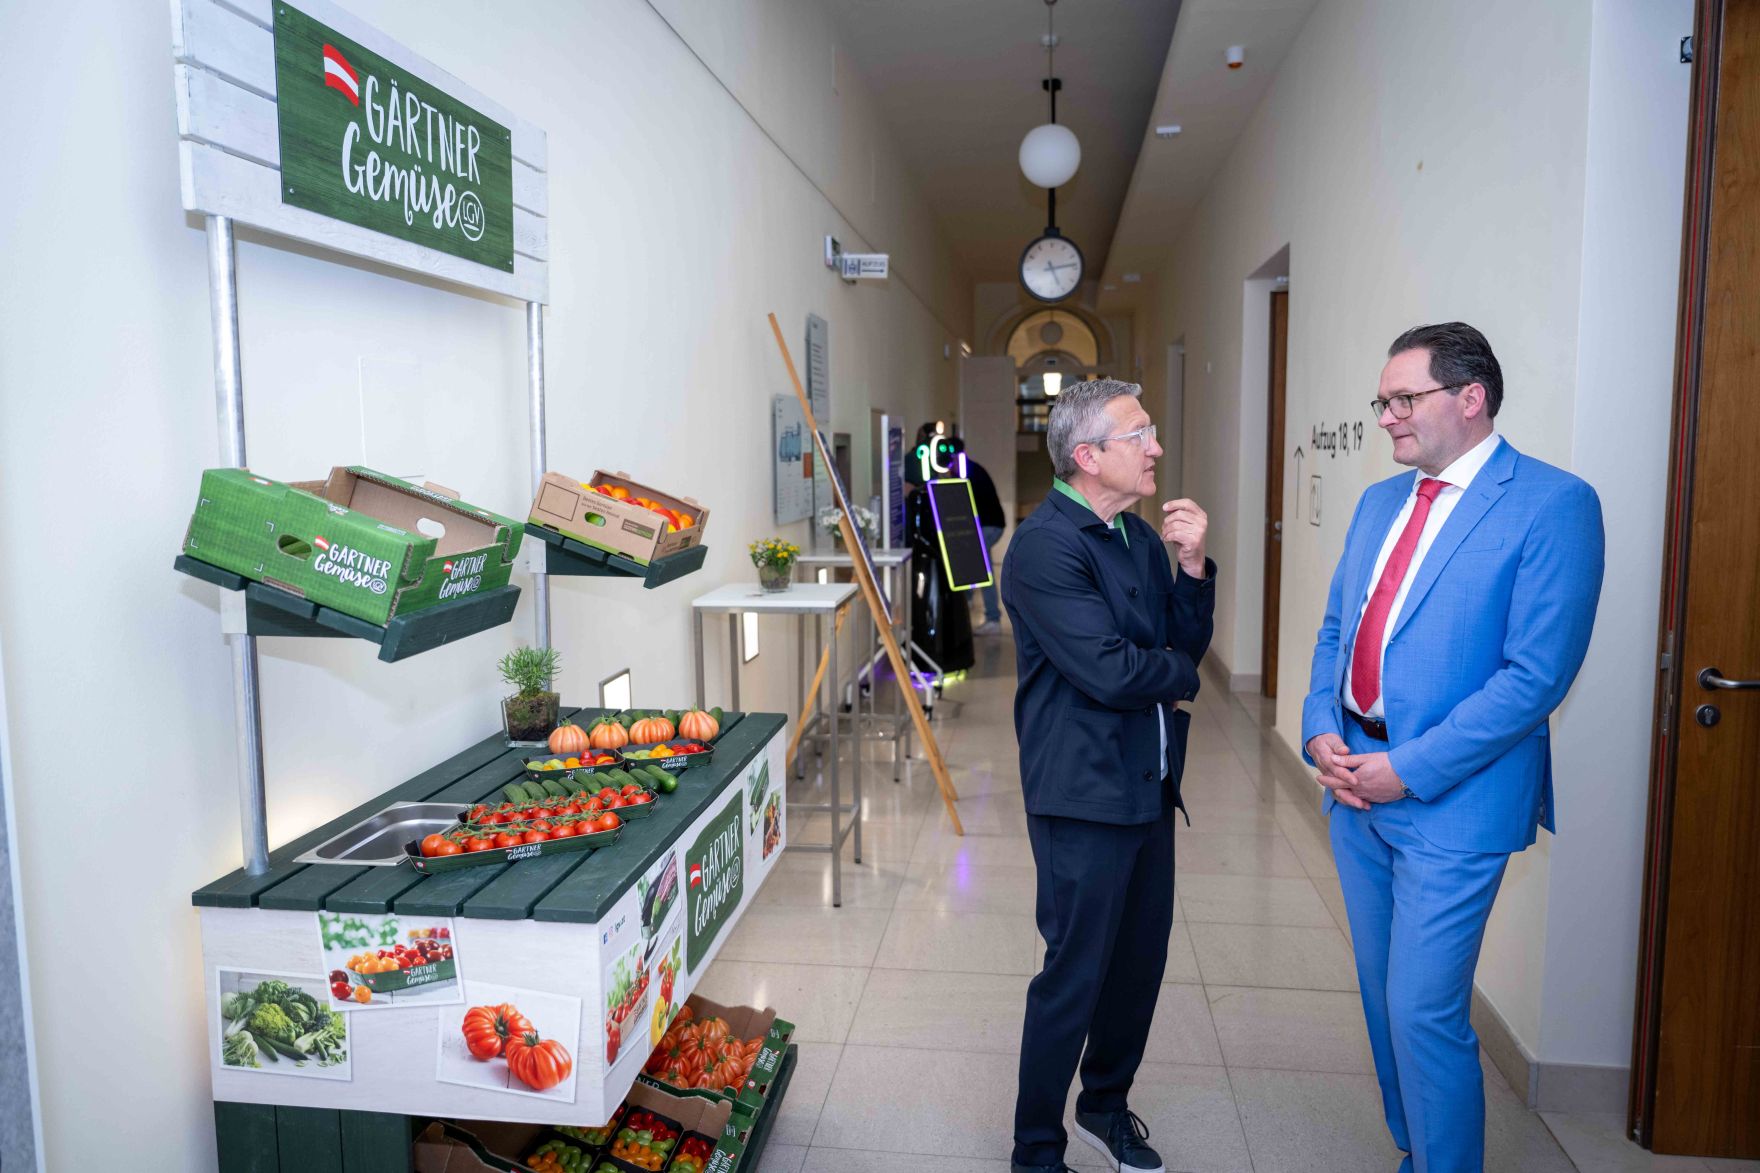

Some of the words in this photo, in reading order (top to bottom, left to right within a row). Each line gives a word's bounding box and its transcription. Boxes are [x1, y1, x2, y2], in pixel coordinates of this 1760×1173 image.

[365, 74, 481, 185] GÄRTNER
[342, 121, 460, 229] Gemüse
[462, 200, 480, 225] LGV
[1311, 421, 1336, 459] Aufzug
[1338, 421, 1350, 457] 18,
[1353, 420, 1363, 451] 19
[314, 553, 372, 588] Gemüse
[329, 543, 392, 579] GÄRTNER
[450, 553, 488, 580] GÄRTNER
[439, 577, 474, 599] Gemüse
[702, 814, 740, 892] GÄRTNER
[694, 866, 732, 937] Gemüse
